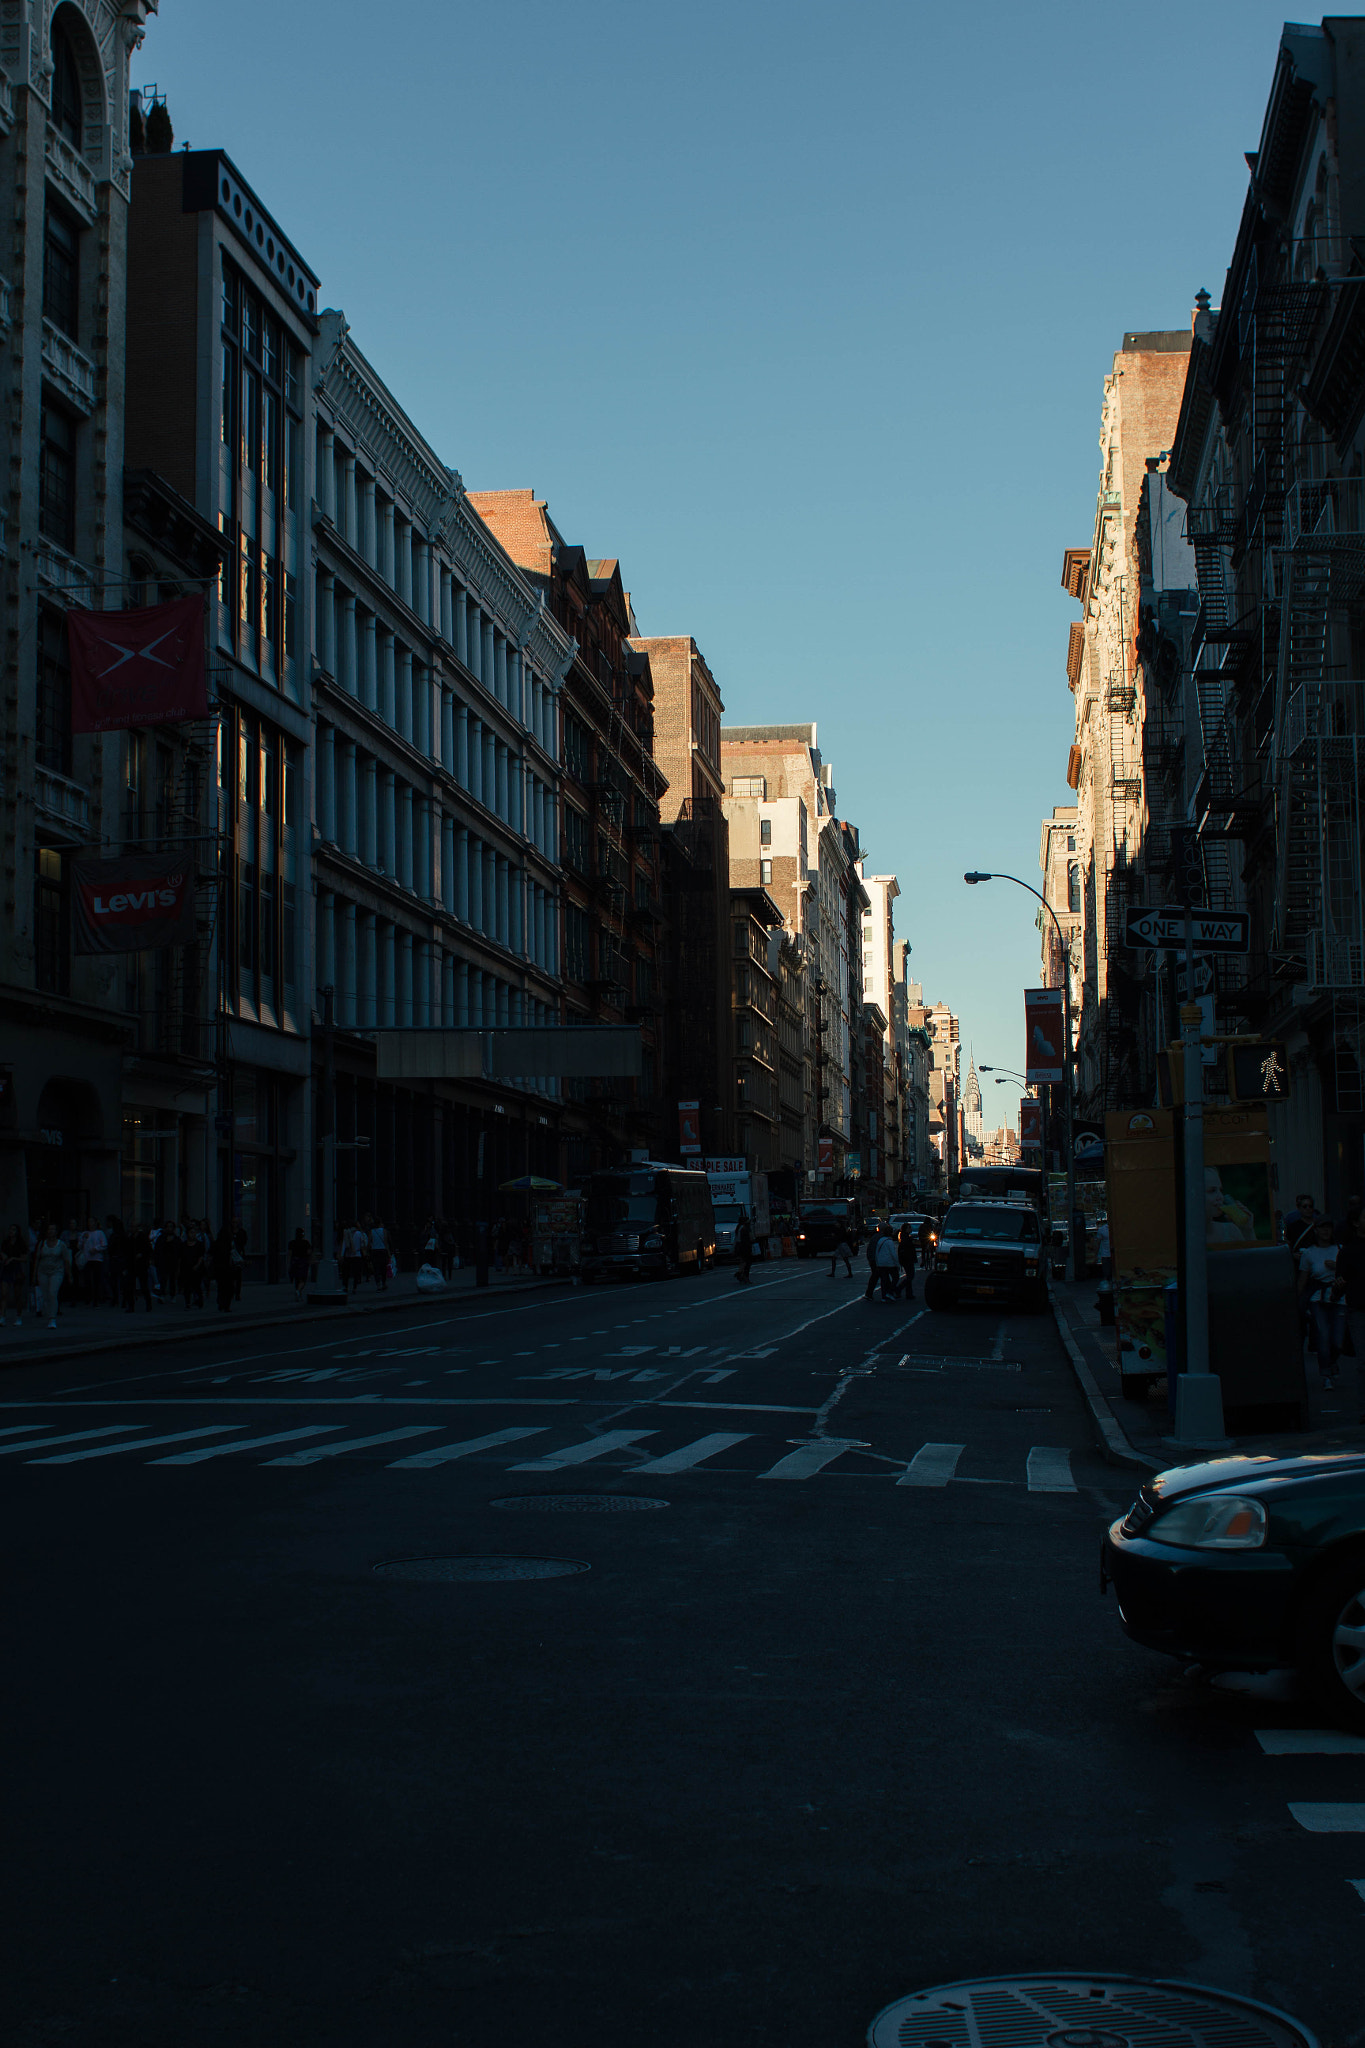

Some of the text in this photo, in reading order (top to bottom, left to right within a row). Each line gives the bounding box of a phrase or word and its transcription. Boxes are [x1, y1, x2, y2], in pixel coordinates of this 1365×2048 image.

[96, 683, 158, 708] drive
[165, 706, 187, 718] club
[1139, 920, 1238, 939] ONE WAY
[1178, 974, 1188, 990] ON
[723, 1160, 743, 1172] SALE
[600, 1345, 780, 1359] FIRE
[512, 1368, 739, 1384] LANE
